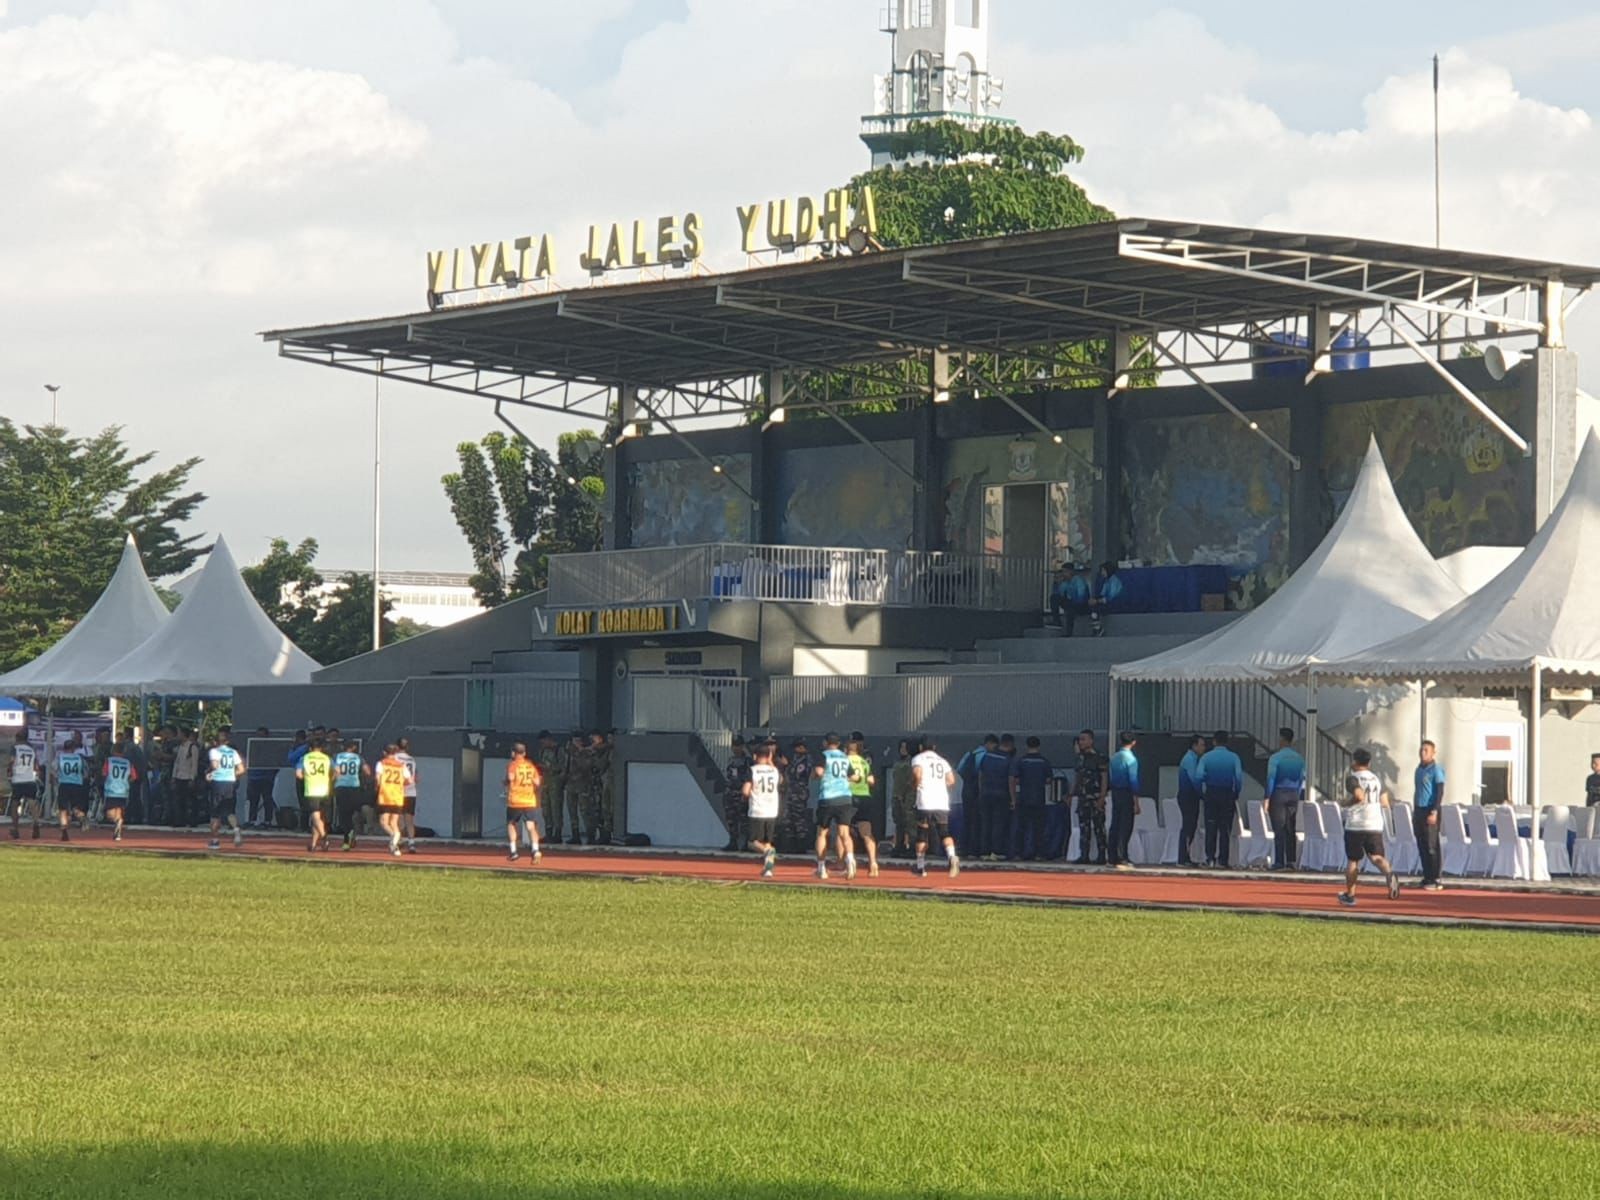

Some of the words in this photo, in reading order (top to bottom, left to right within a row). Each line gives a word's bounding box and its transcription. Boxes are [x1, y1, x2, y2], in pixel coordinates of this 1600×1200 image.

[427, 233, 557, 293] VIYATA
[580, 213, 704, 270] JALES
[736, 185, 878, 251] YUDHA
[598, 608, 665, 632] KOARMADA
[19, 754, 33, 767] 17
[63, 761, 80, 776] 04
[339, 761, 357, 776] 08
[112, 766, 128, 779] 07
[309, 761, 326, 777] 34
[384, 769, 401, 785] 22
[831, 760, 848, 779] 05
[929, 762, 945, 780] 19
[519, 771, 534, 787] 25
[758, 776, 775, 794] 15
